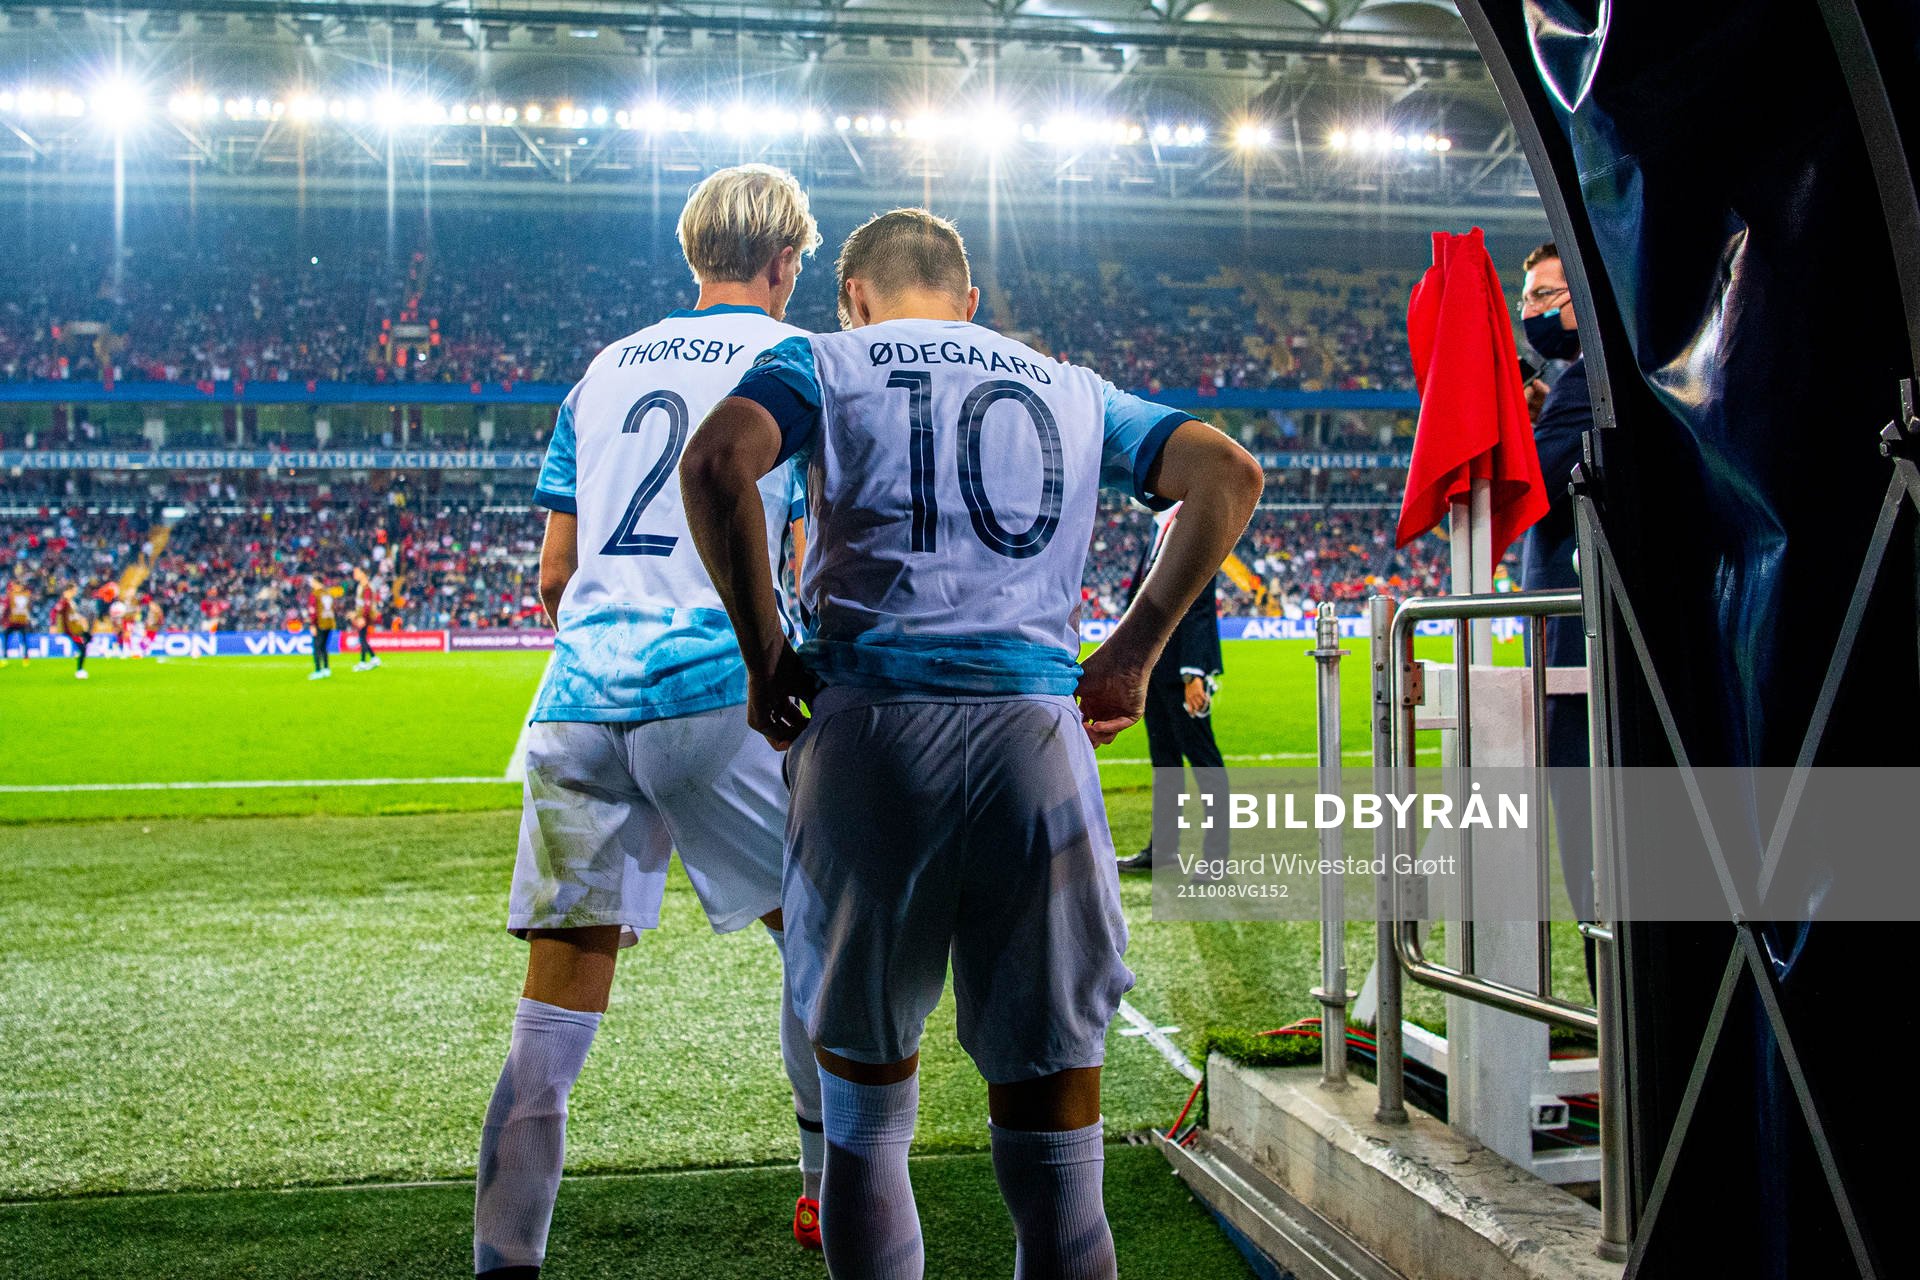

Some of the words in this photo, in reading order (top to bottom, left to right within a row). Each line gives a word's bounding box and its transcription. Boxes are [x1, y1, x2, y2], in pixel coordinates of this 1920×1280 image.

[617, 337, 745, 368] THORSBY
[869, 340, 1053, 386] ØDEGAARD
[599, 389, 690, 557] 2
[886, 370, 1065, 559] 10
